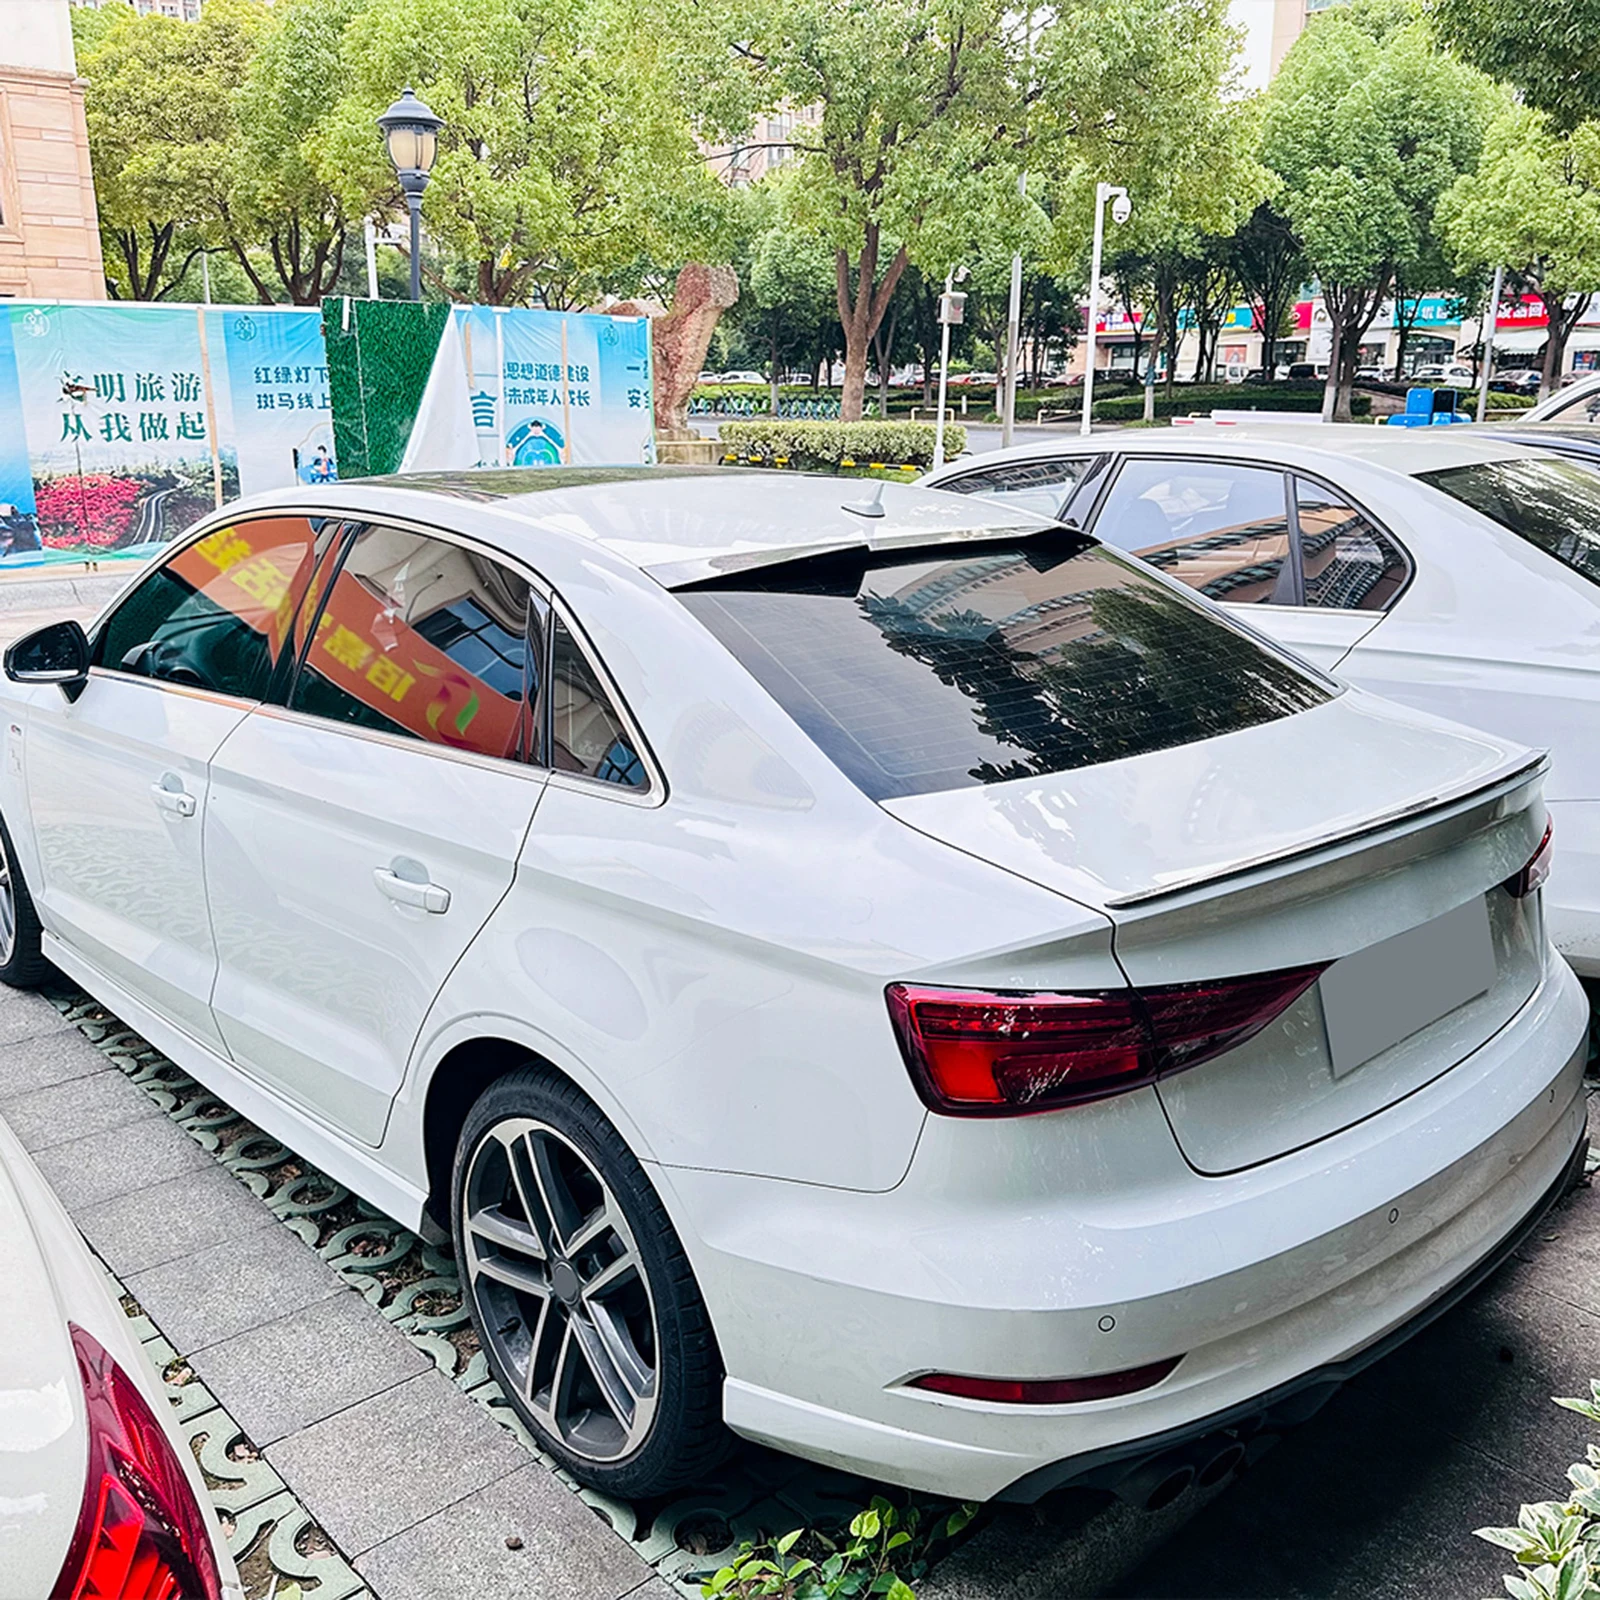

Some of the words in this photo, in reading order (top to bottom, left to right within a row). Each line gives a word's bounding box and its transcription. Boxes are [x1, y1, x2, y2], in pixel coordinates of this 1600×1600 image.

[254, 366, 330, 384] 红绿灯下
[503, 362, 590, 382] 思想道德建设
[626, 360, 648, 379] 一
[256, 392, 332, 410] 斑马线上
[503, 387, 590, 406] 未成年人成长
[60, 411, 207, 443] 从我做起
